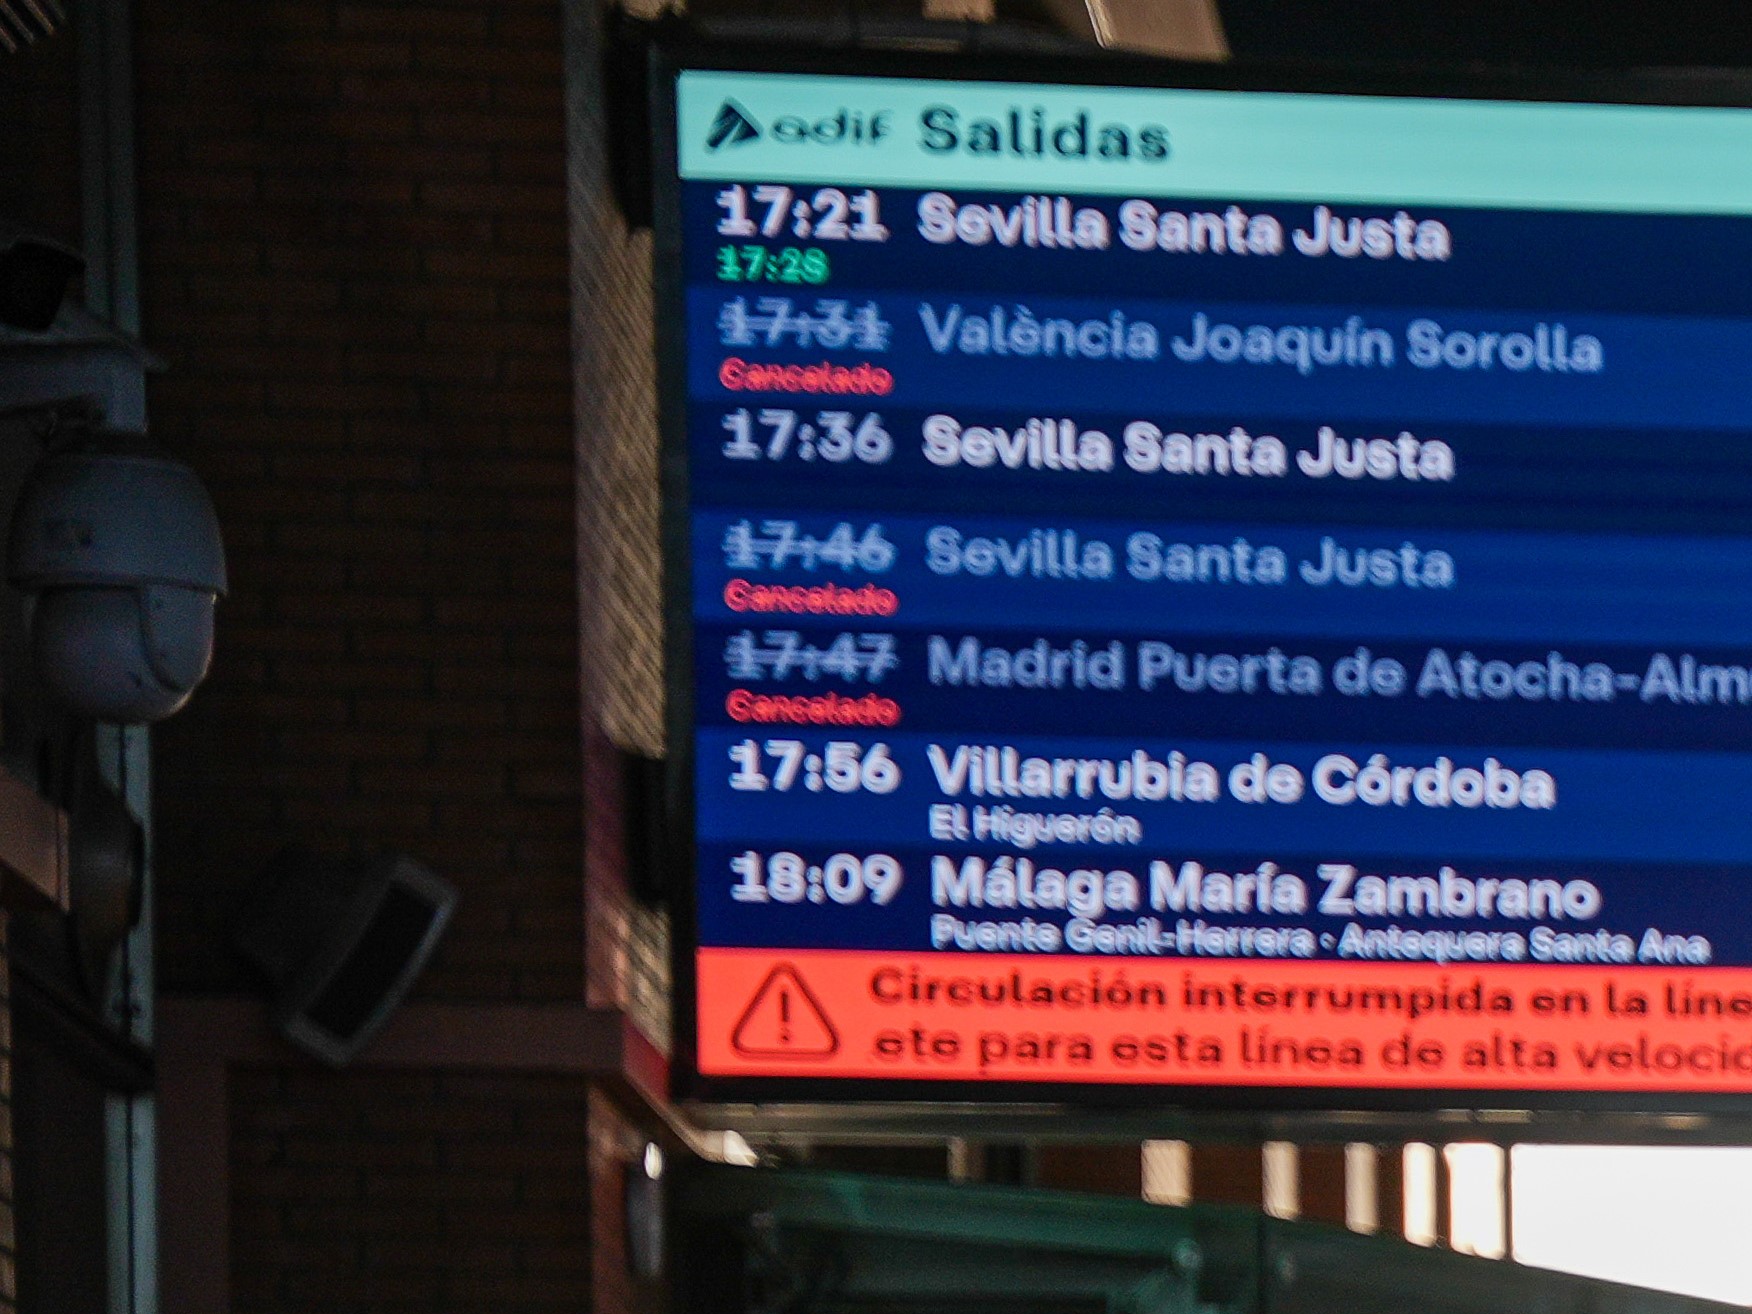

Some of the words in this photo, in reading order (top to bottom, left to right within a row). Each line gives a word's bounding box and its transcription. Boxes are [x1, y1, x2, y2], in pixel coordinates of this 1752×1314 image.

[770, 110, 886, 145] adif
[919, 107, 1172, 162] Salidas
[719, 188, 886, 241] 17:21
[919, 195, 1108, 251] Sevilla
[1121, 201, 1283, 255] Santa
[1295, 207, 1451, 260] Justa
[719, 249, 828, 283] 17:28
[922, 303, 1159, 360] València
[1173, 313, 1393, 373] Joaquín
[1408, 320, 1604, 373] Sorolla
[720, 360, 892, 395] Cancelado
[724, 411, 892, 461] 17:36
[923, 416, 1112, 471] Sevilla
[1125, 422, 1286, 476] Santa
[1299, 427, 1454, 481] Justa
[726, 634, 898, 680] 17:47
[930, 636, 1125, 691] Madrid
[1140, 639, 1320, 693] Puerta
[1335, 644, 1404, 696] de
[729, 742, 899, 794] 17:56
[929, 744, 1215, 803] Villarrubia
[1230, 752, 1301, 803] de
[1312, 751, 1557, 809] Córdoba
[931, 806, 970, 840] El
[979, 808, 1142, 850] Higuerón
[731, 853, 901, 904] 18:09
[934, 856, 1136, 917] Málaga
[1151, 861, 1305, 917] María
[1319, 865, 1600, 922] Zambrano
[932, 918, 1061, 952] Puente
[1067, 919, 1313, 957] Genil-Herrera
[1340, 924, 1523, 966] Antequera
[1530, 927, 1632, 964] Santa
[1637, 930, 1711, 964] Ana
